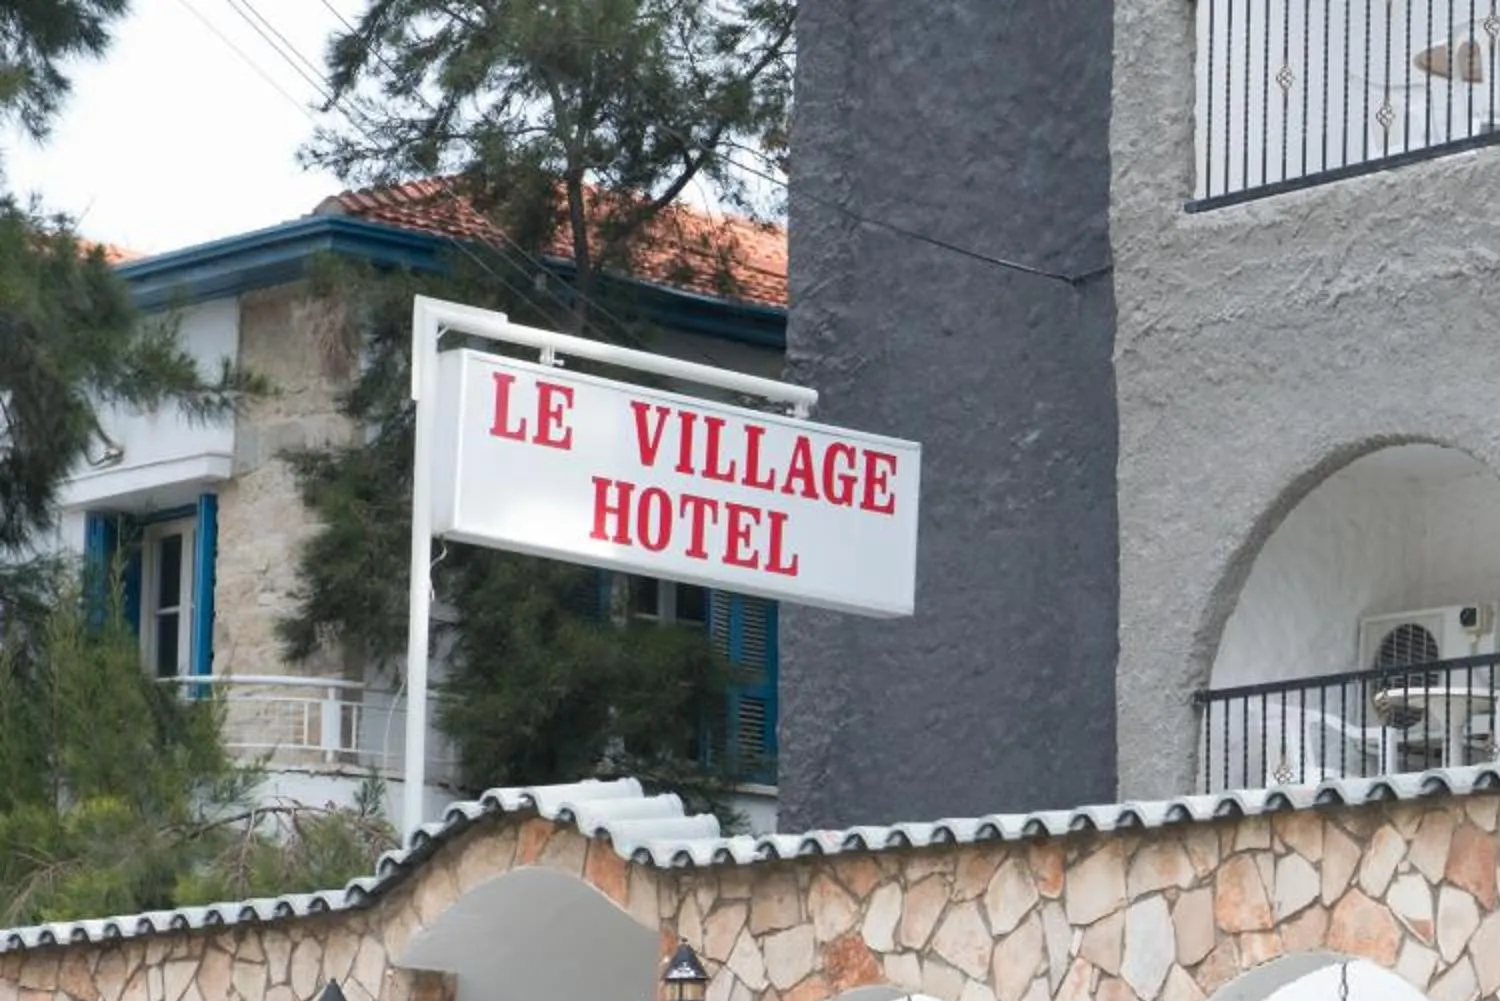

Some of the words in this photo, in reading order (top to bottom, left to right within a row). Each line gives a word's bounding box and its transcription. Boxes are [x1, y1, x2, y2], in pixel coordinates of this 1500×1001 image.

[489, 371, 574, 451] LE
[631, 400, 897, 516] VILLAGE
[589, 475, 799, 578] HOTEL
